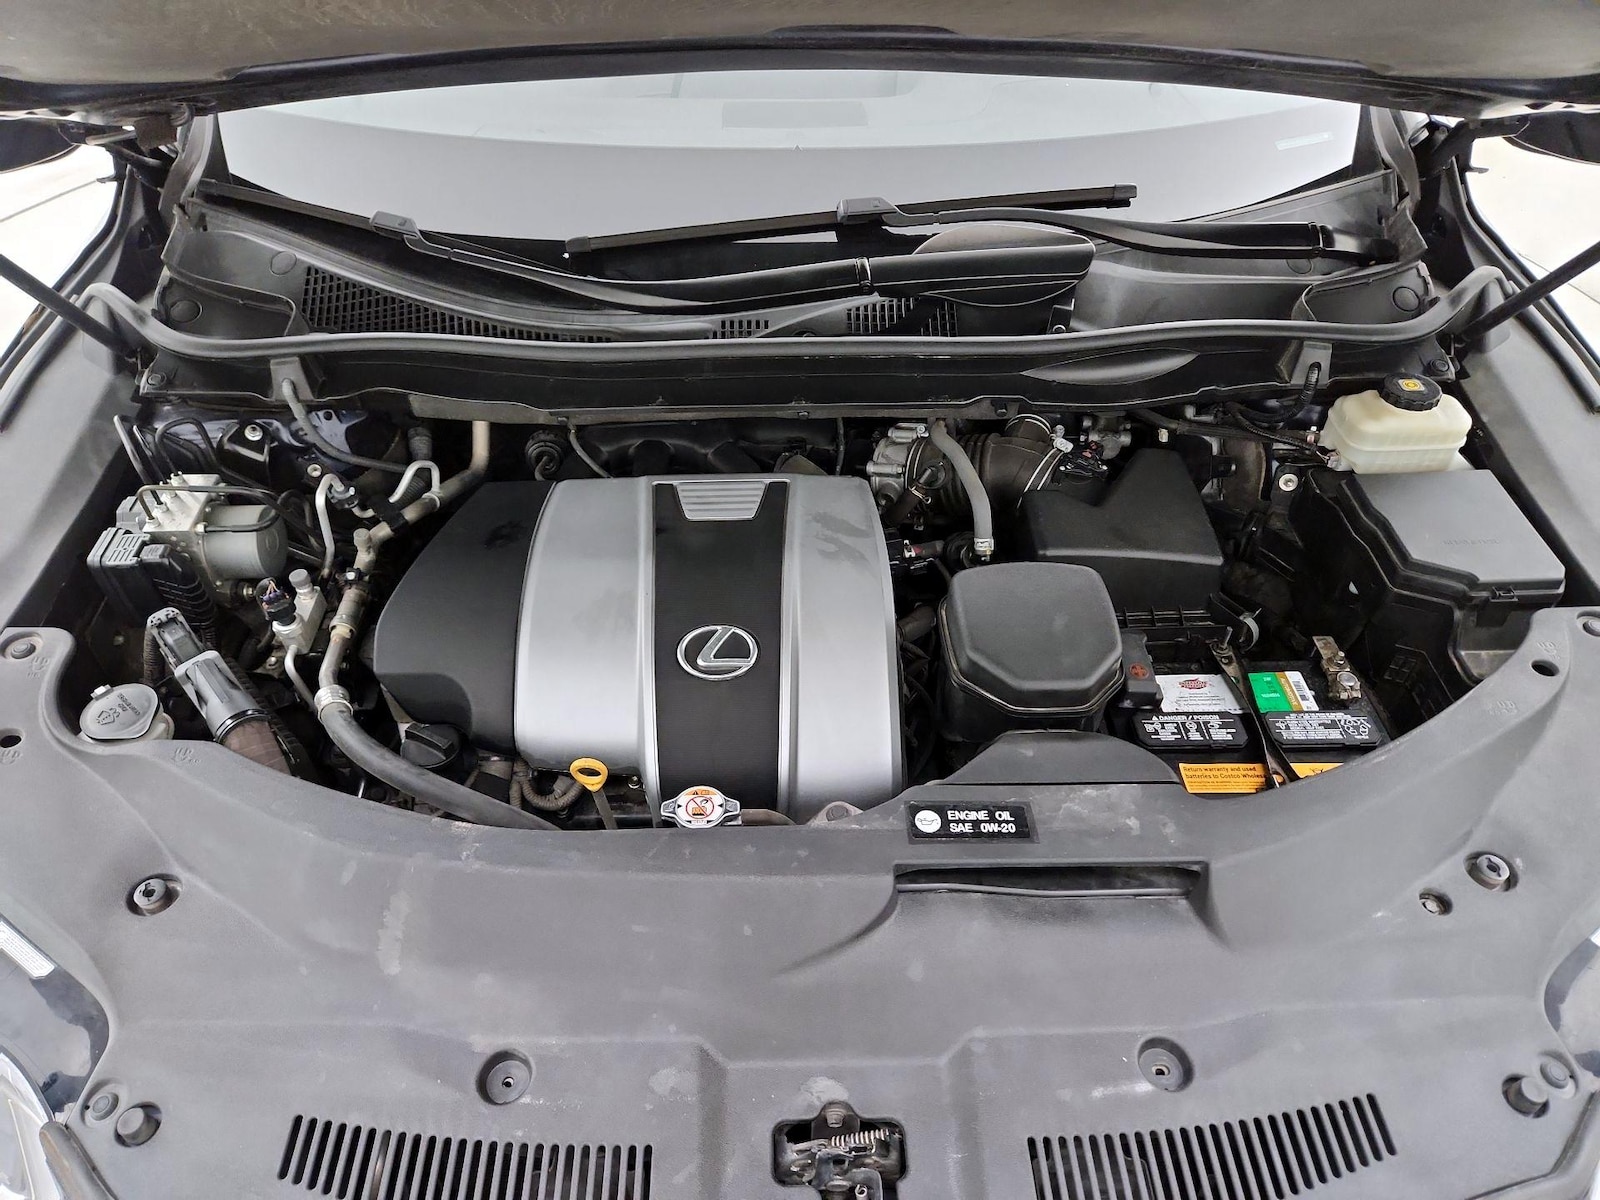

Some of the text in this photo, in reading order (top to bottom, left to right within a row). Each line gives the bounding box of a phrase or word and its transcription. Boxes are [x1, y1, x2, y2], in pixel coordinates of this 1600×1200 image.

[947, 810, 1015, 821] ENGINE OIL
[949, 823, 1016, 833] SAE 0W-20
